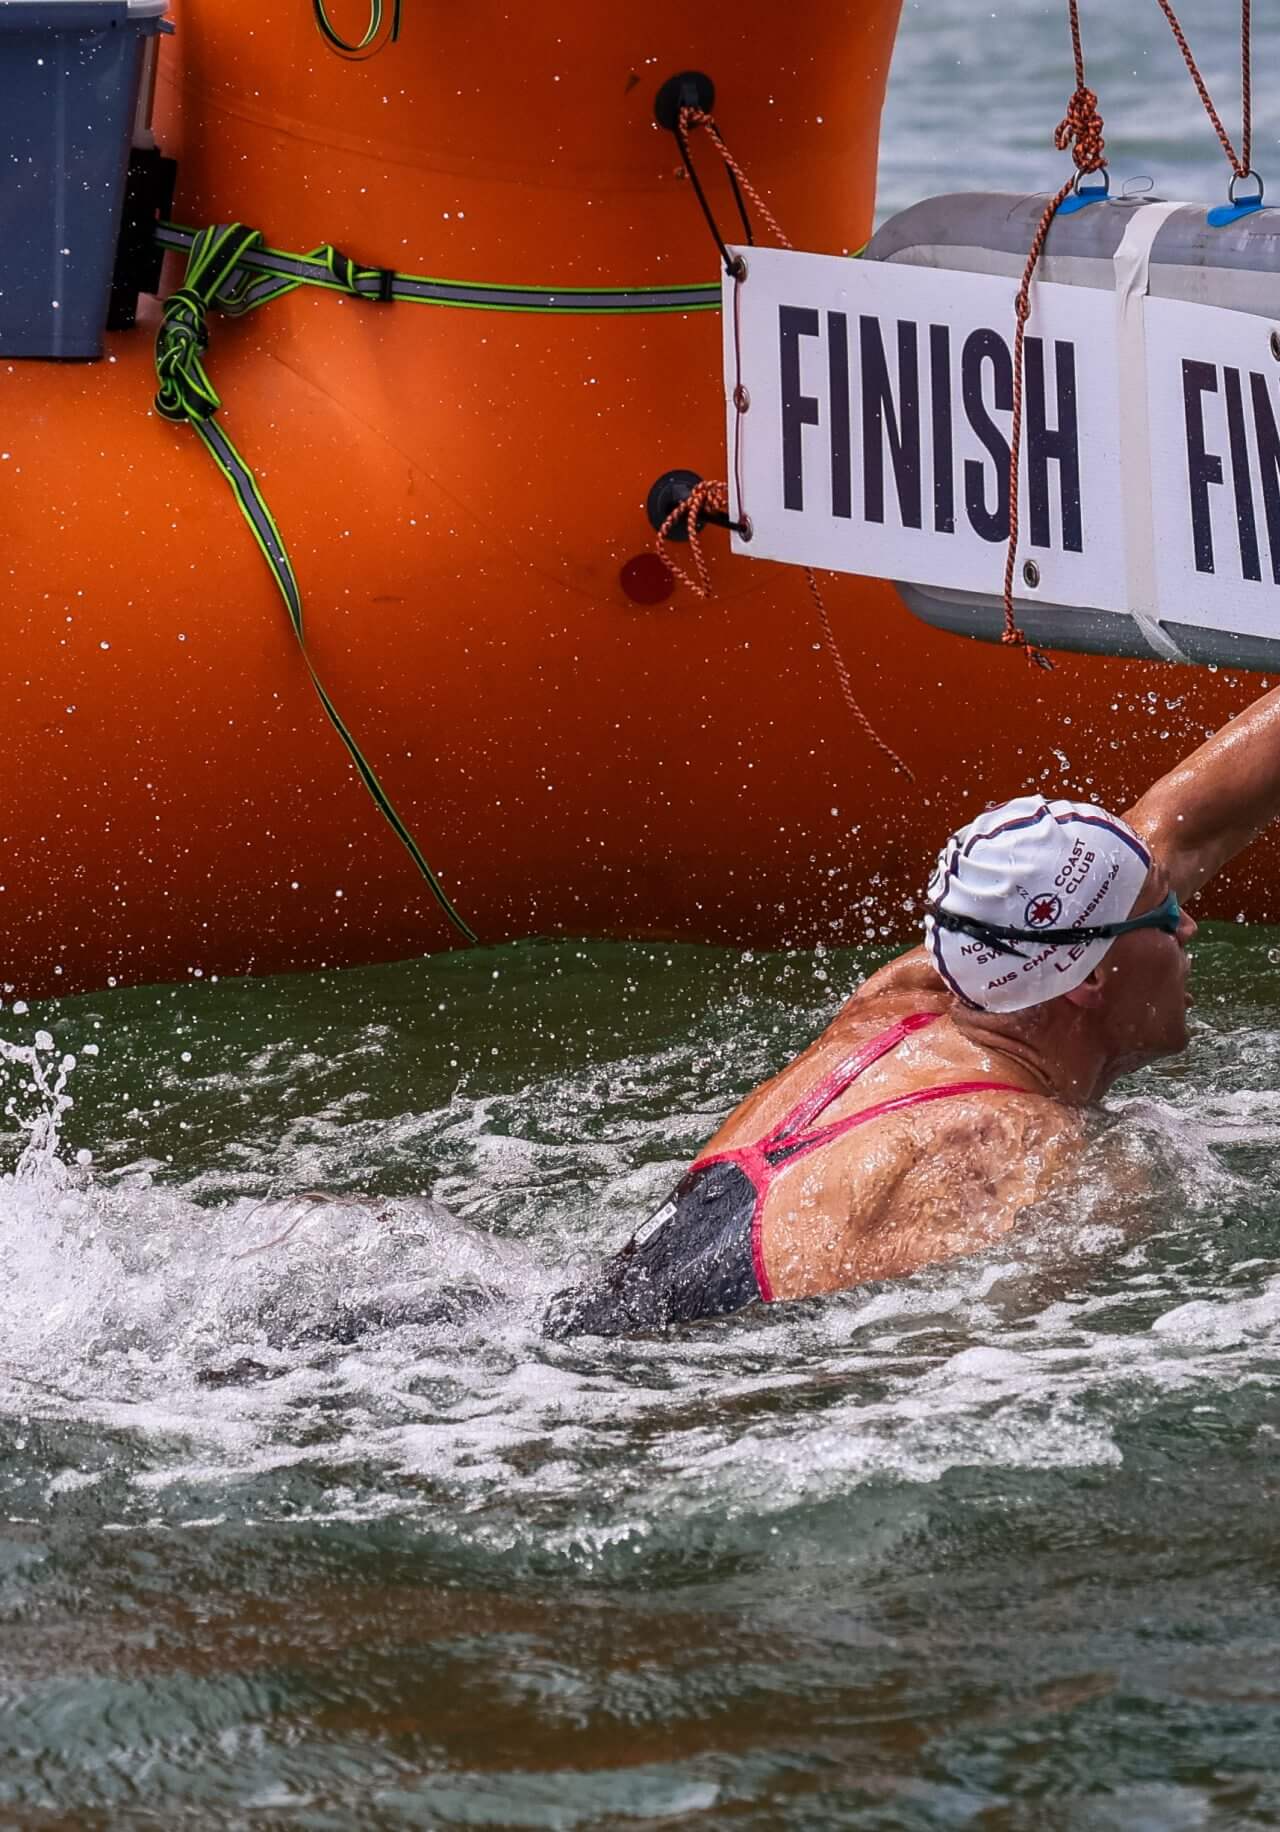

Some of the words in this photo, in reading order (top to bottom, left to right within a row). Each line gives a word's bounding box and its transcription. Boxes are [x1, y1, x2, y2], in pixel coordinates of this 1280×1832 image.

[779, 304, 1084, 553] FINISH
[1054, 838, 1086, 887] COAST
[1065, 851, 1096, 894] CLUB
[987, 970, 1019, 990] AUS
